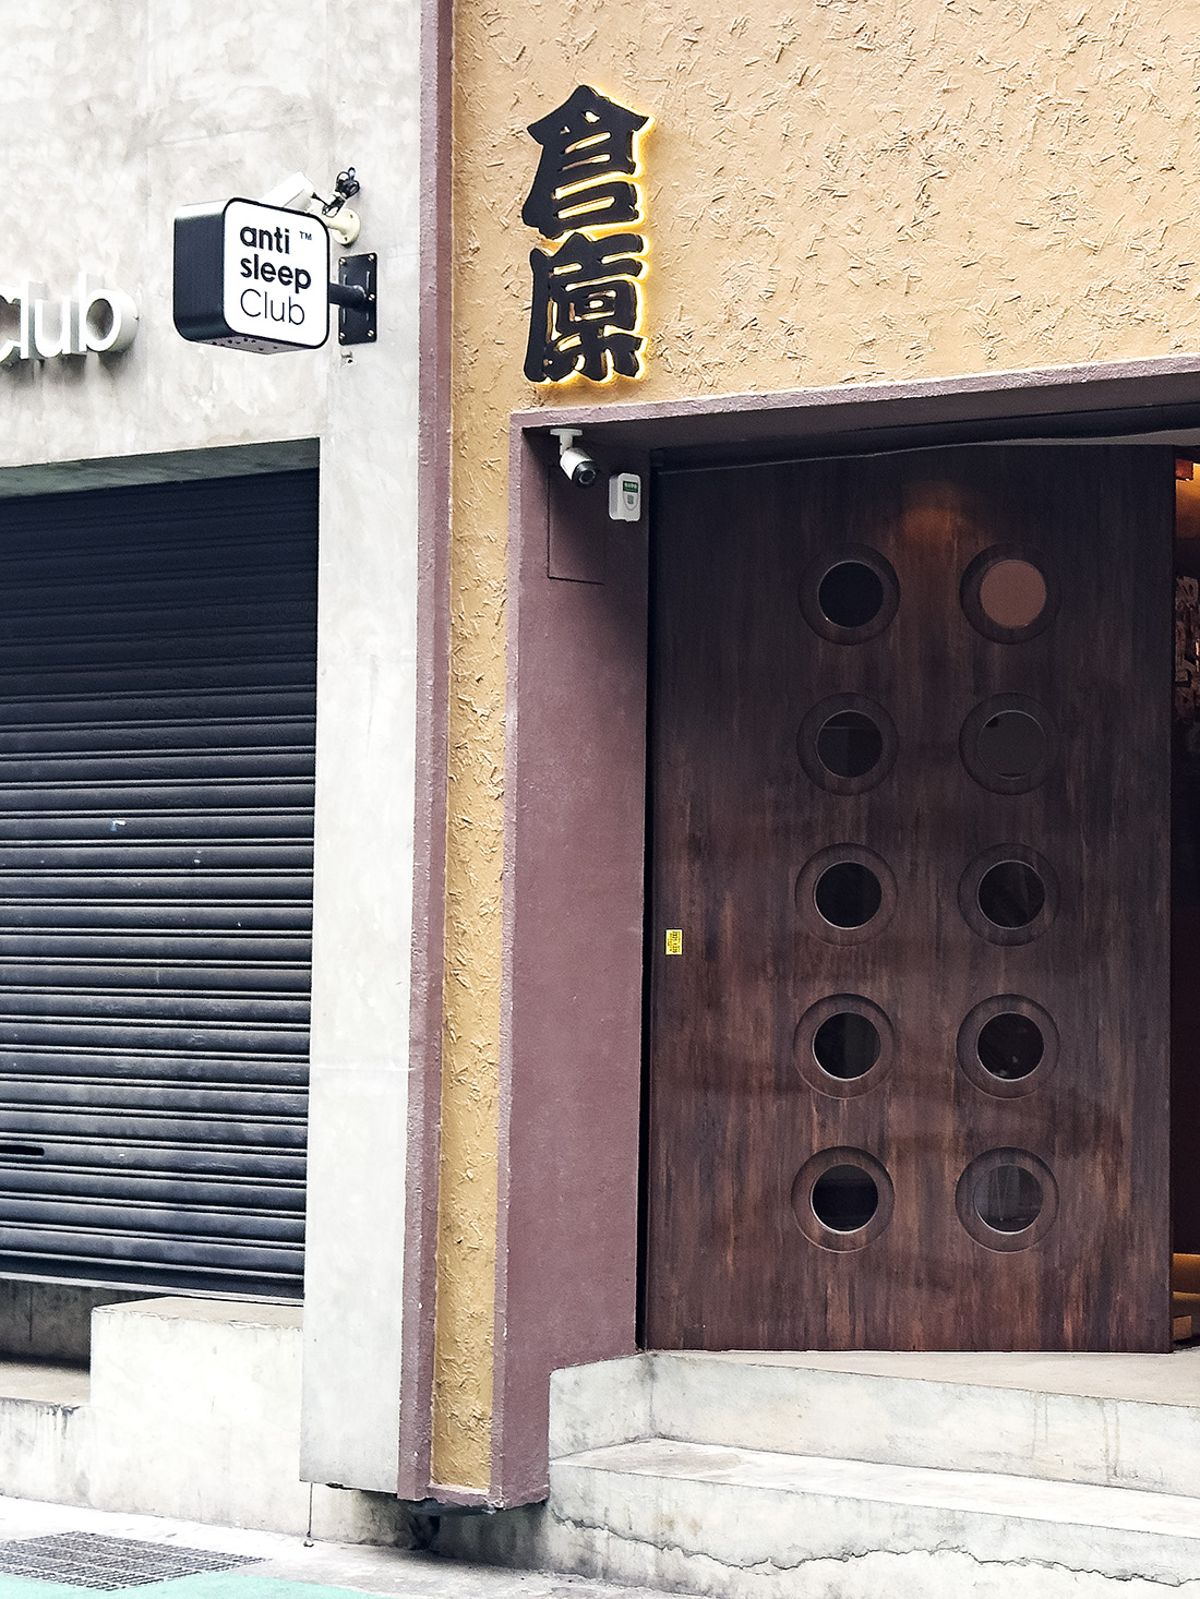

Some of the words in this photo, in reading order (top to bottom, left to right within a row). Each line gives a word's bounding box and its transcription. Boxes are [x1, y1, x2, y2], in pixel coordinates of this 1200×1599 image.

[240, 226, 290, 254] anti
[240, 253, 312, 294] sleep
[240, 288, 306, 326] Club
